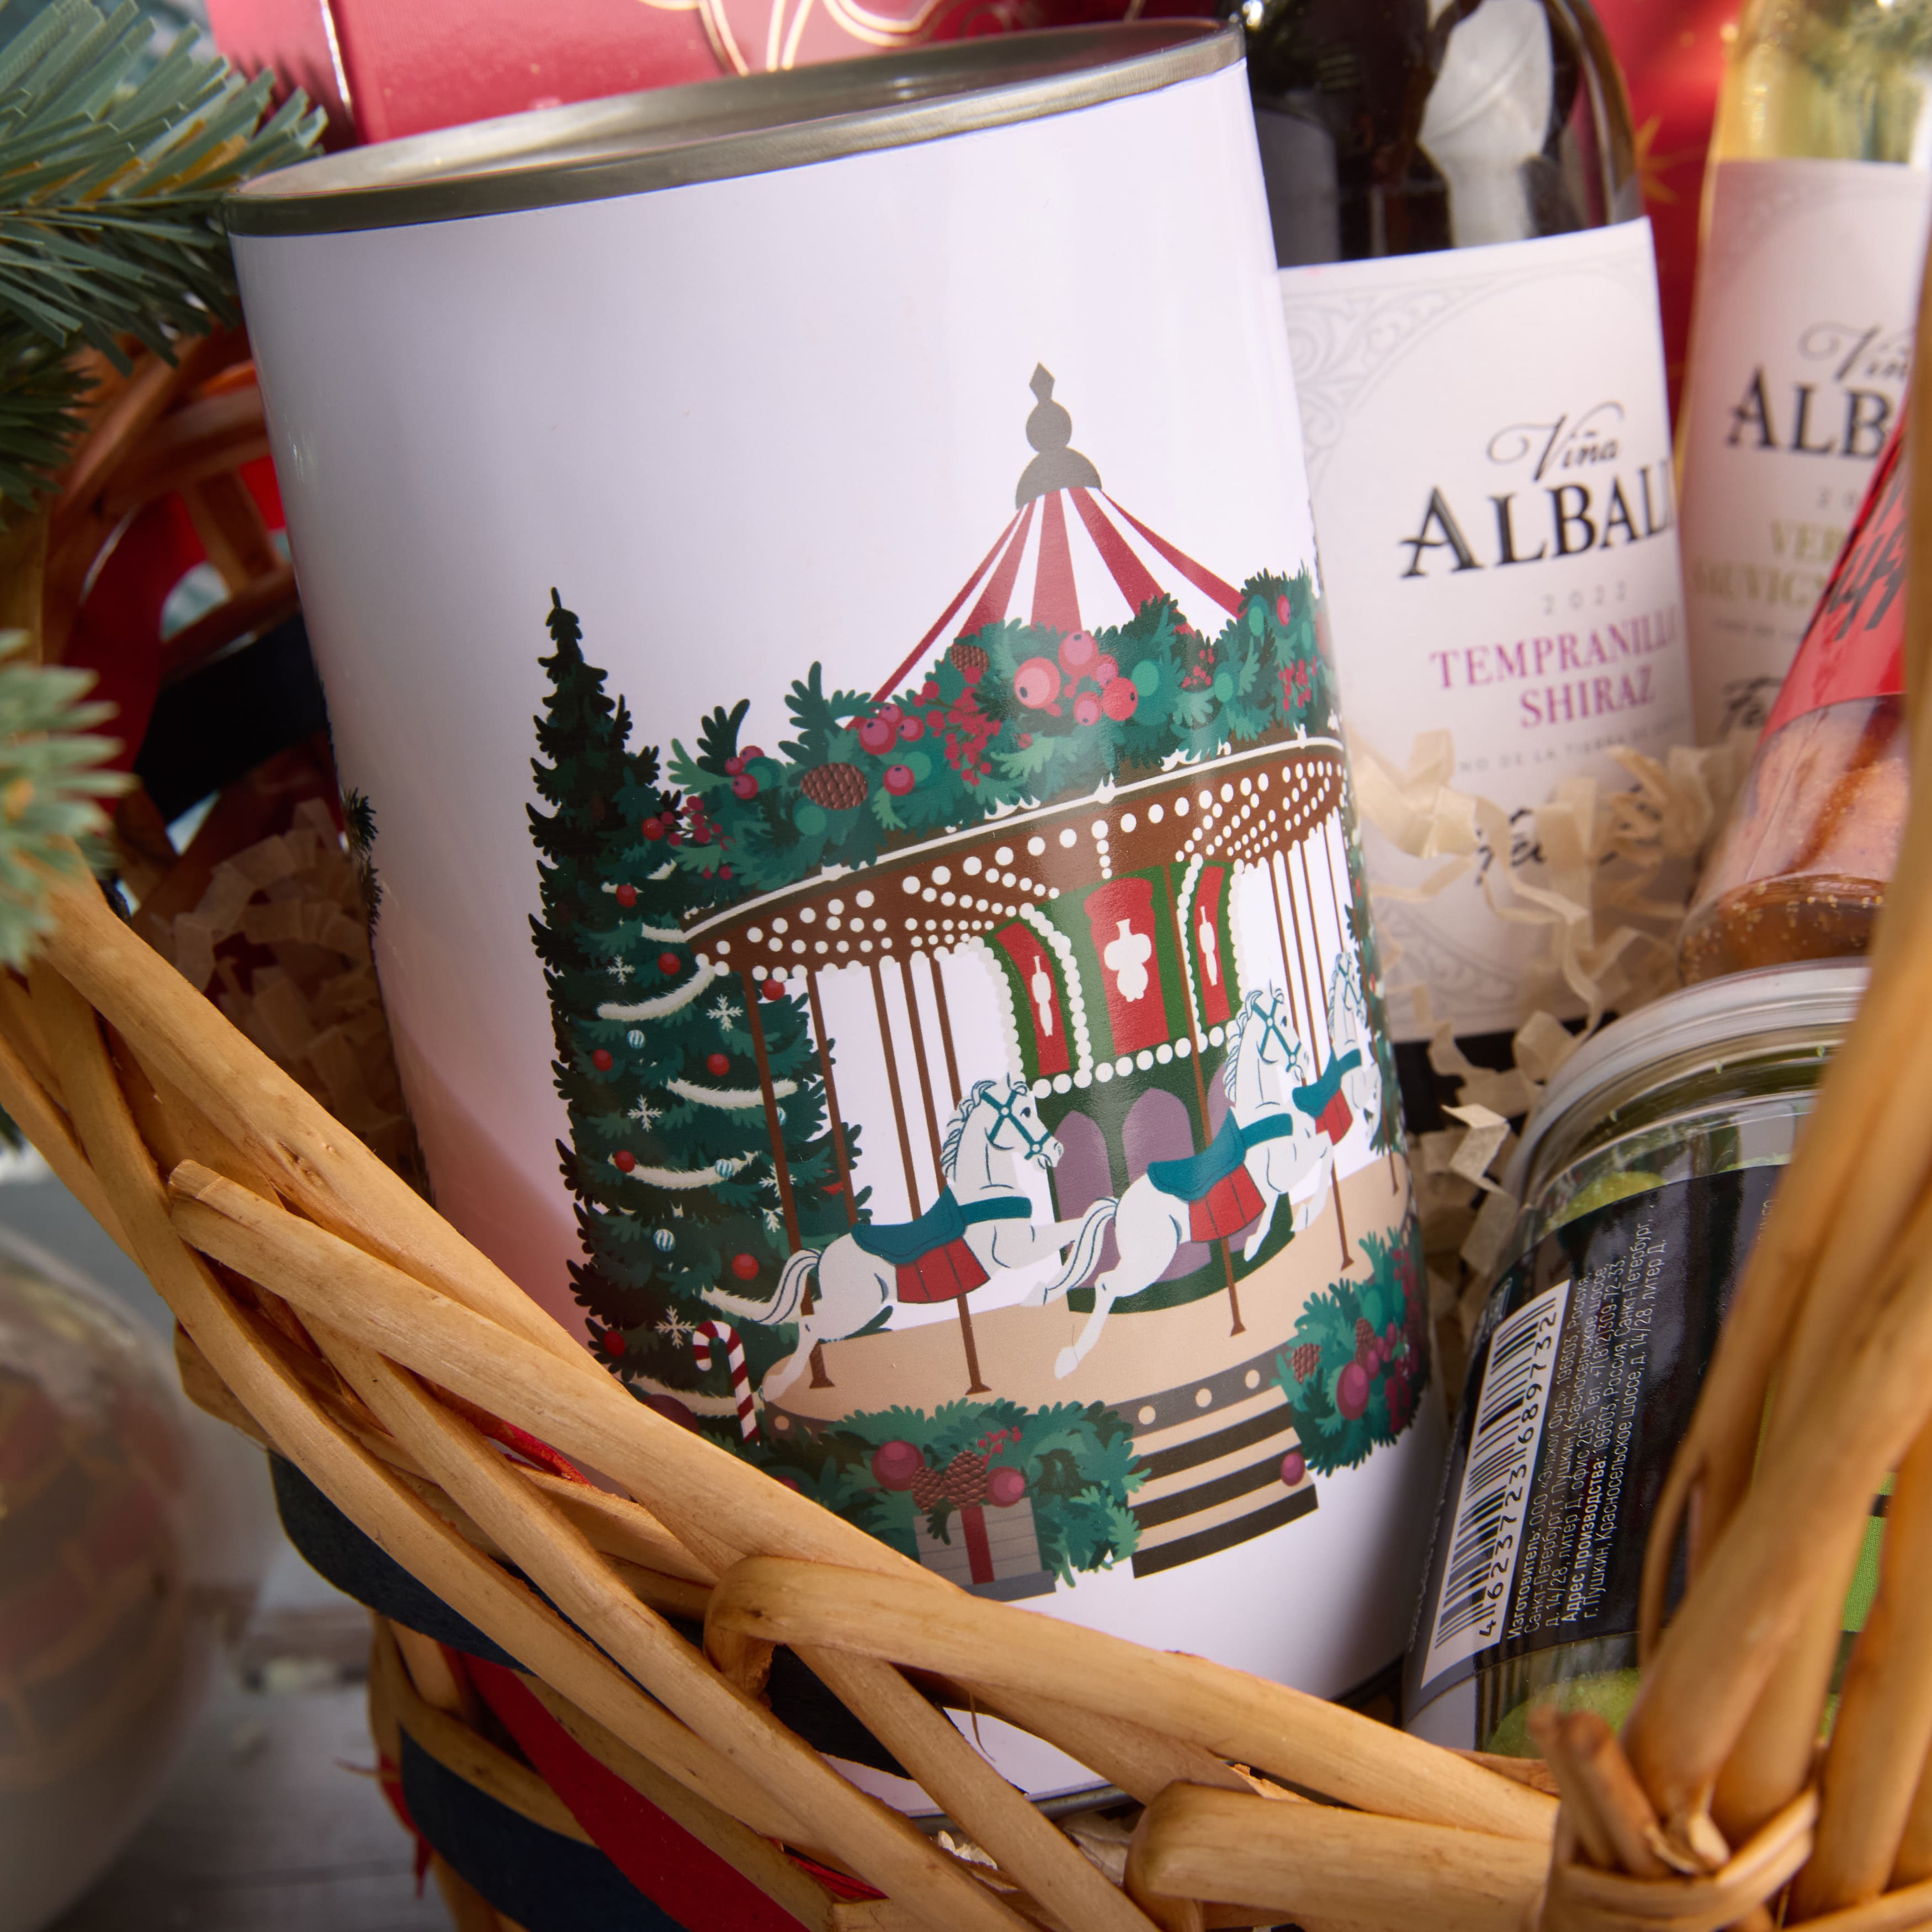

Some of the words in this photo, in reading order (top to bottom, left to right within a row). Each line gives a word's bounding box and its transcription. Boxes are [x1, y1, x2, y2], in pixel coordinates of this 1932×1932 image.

[1487, 401, 1626, 483] Viña
[1541, 580, 1628, 617] 2022
[1520, 664, 1655, 730] SHIRAZ
[1567, 1273, 1591, 1328] Россия,
[1614, 1219, 1652, 1335] Санкт-Петербург,
[1643, 1259, 1665, 1298] литер
[1630, 1304, 1656, 1347] 14/28,
[1557, 1331, 1580, 1384] 196603,
[1604, 1340, 1630, 1395] Россия,
[1621, 1368, 1644, 1416] шоссе,
[1525, 1508, 1563, 1632] Санкт-Петербург,
[1563, 1315, 1597, 1431] Красносельское
[1589, 1264, 1610, 1312] шоссе,
[1593, 1399, 1620, 1453] 196603,
[1559, 1514, 1580, 1557] литер
[1572, 1450, 1589, 1489] офис
[1595, 1422, 1632, 1540] Красносельское
[1530, 1494, 1547, 1525] ООО
[1574, 1456, 1607, 1568] производства:
[1507, 1528, 1541, 1638] Изготовитель:
[1561, 1573, 1585, 1621] Адрес
[1583, 1543, 1613, 1605] Пушкин,
